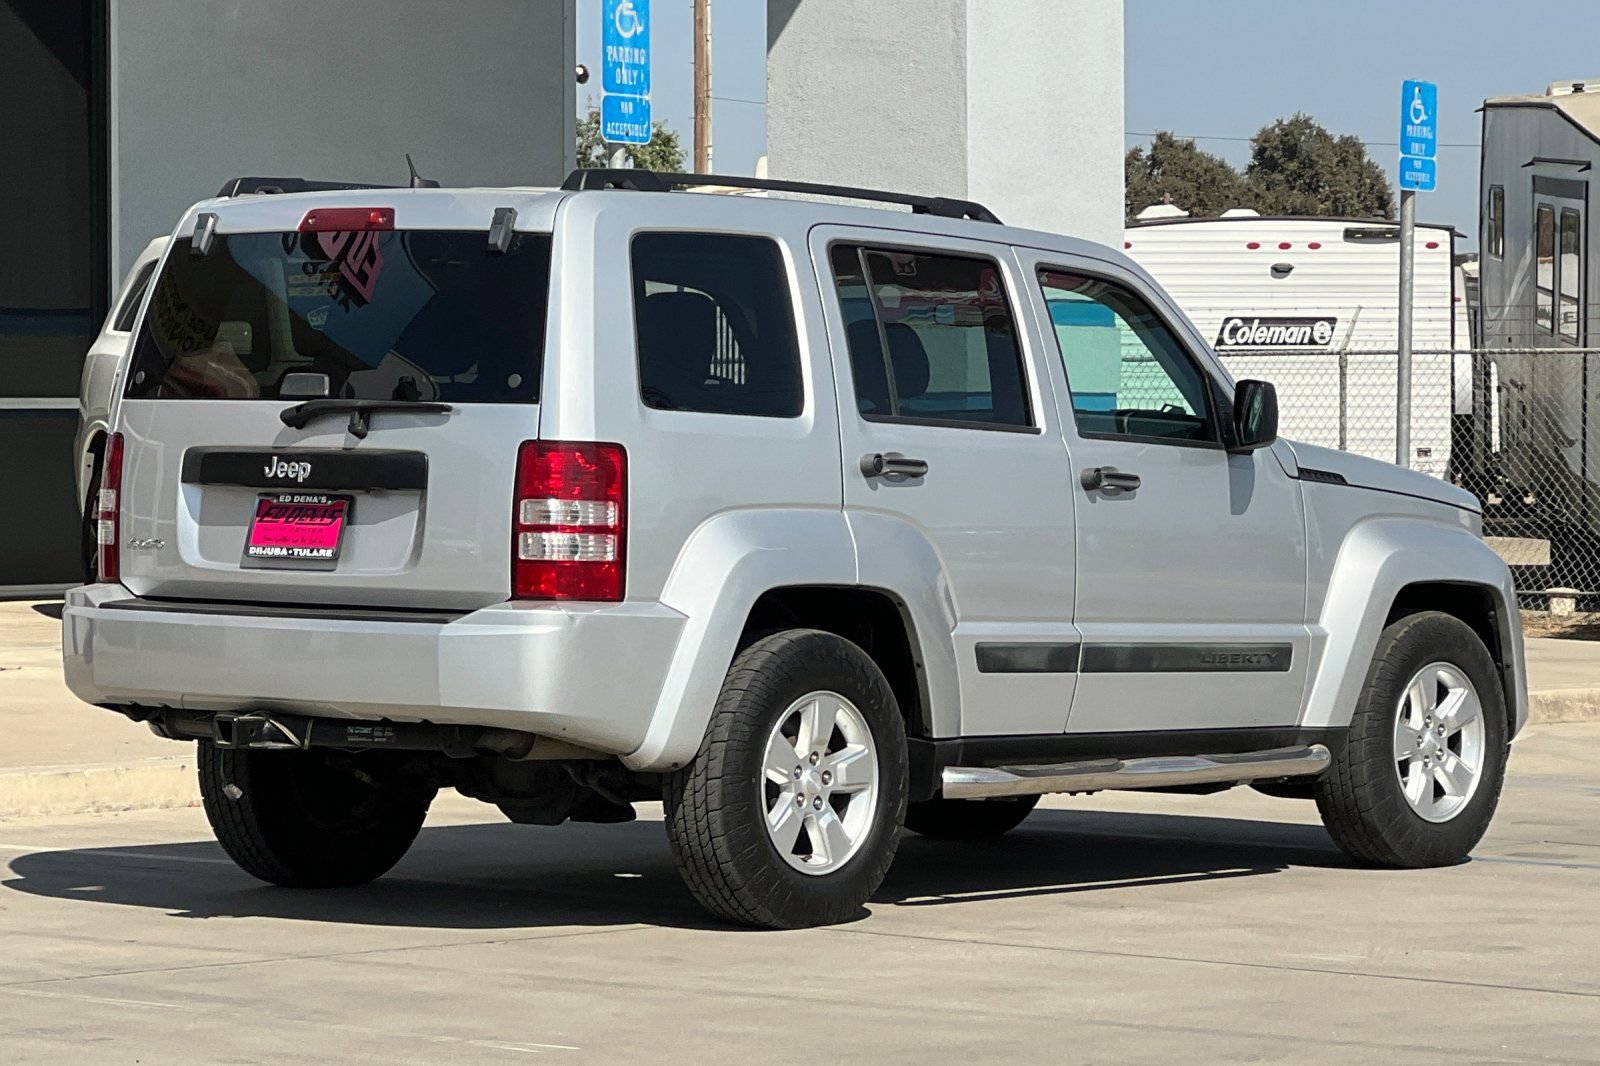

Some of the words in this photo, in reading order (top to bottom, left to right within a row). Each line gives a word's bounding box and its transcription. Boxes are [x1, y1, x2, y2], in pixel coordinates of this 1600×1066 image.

[607, 46, 646, 65] PARKING
[616, 68, 638, 85] ONLY
[607, 122, 647, 137] ACCESSIBLE
[1223, 318, 1312, 345] Coleman
[264, 457, 311, 482] Jeep
[279, 495, 292, 503] ED
[293, 495, 327, 503] DENA'S
[292, 548, 333, 557] TULARE
[1200, 652, 1279, 664] LIBERTY
